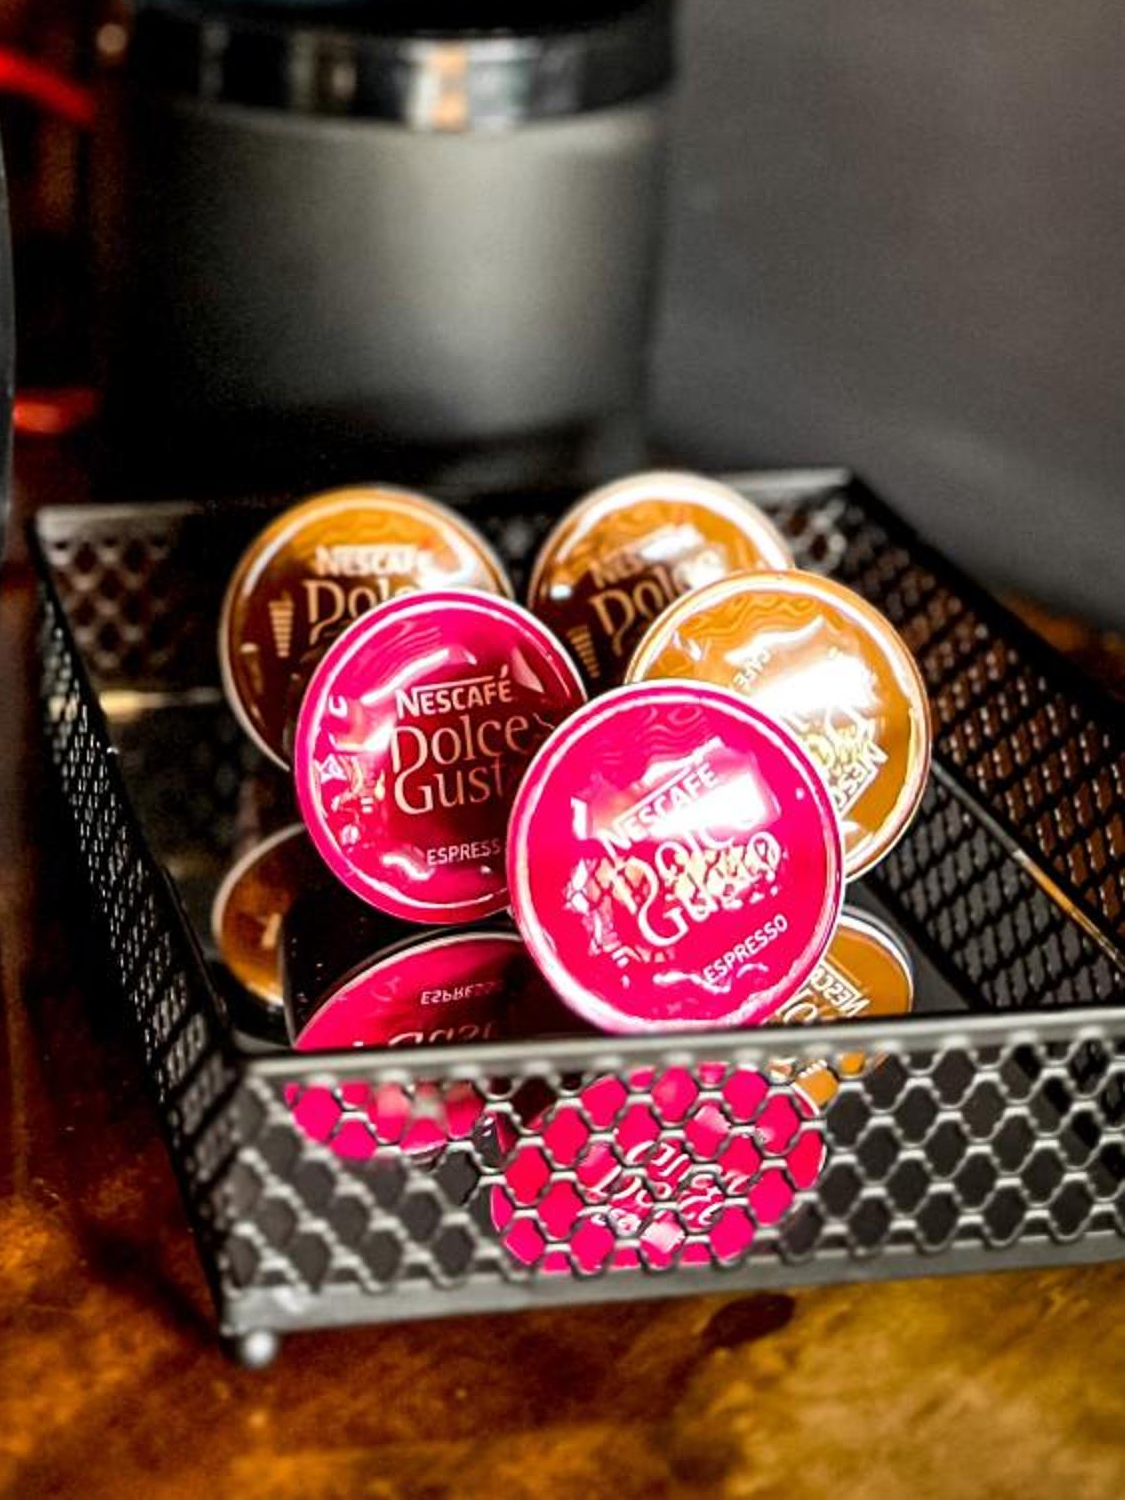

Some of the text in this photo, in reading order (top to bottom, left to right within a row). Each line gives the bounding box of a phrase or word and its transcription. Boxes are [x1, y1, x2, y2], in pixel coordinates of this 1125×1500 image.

[395, 664, 513, 720] NESCAFÉ
[390, 713, 529, 774] Dolce
[393, 756, 511, 815] Gust
[427, 838, 502, 867] ESPRESS
[703, 913, 789, 985] ESPRESSO
